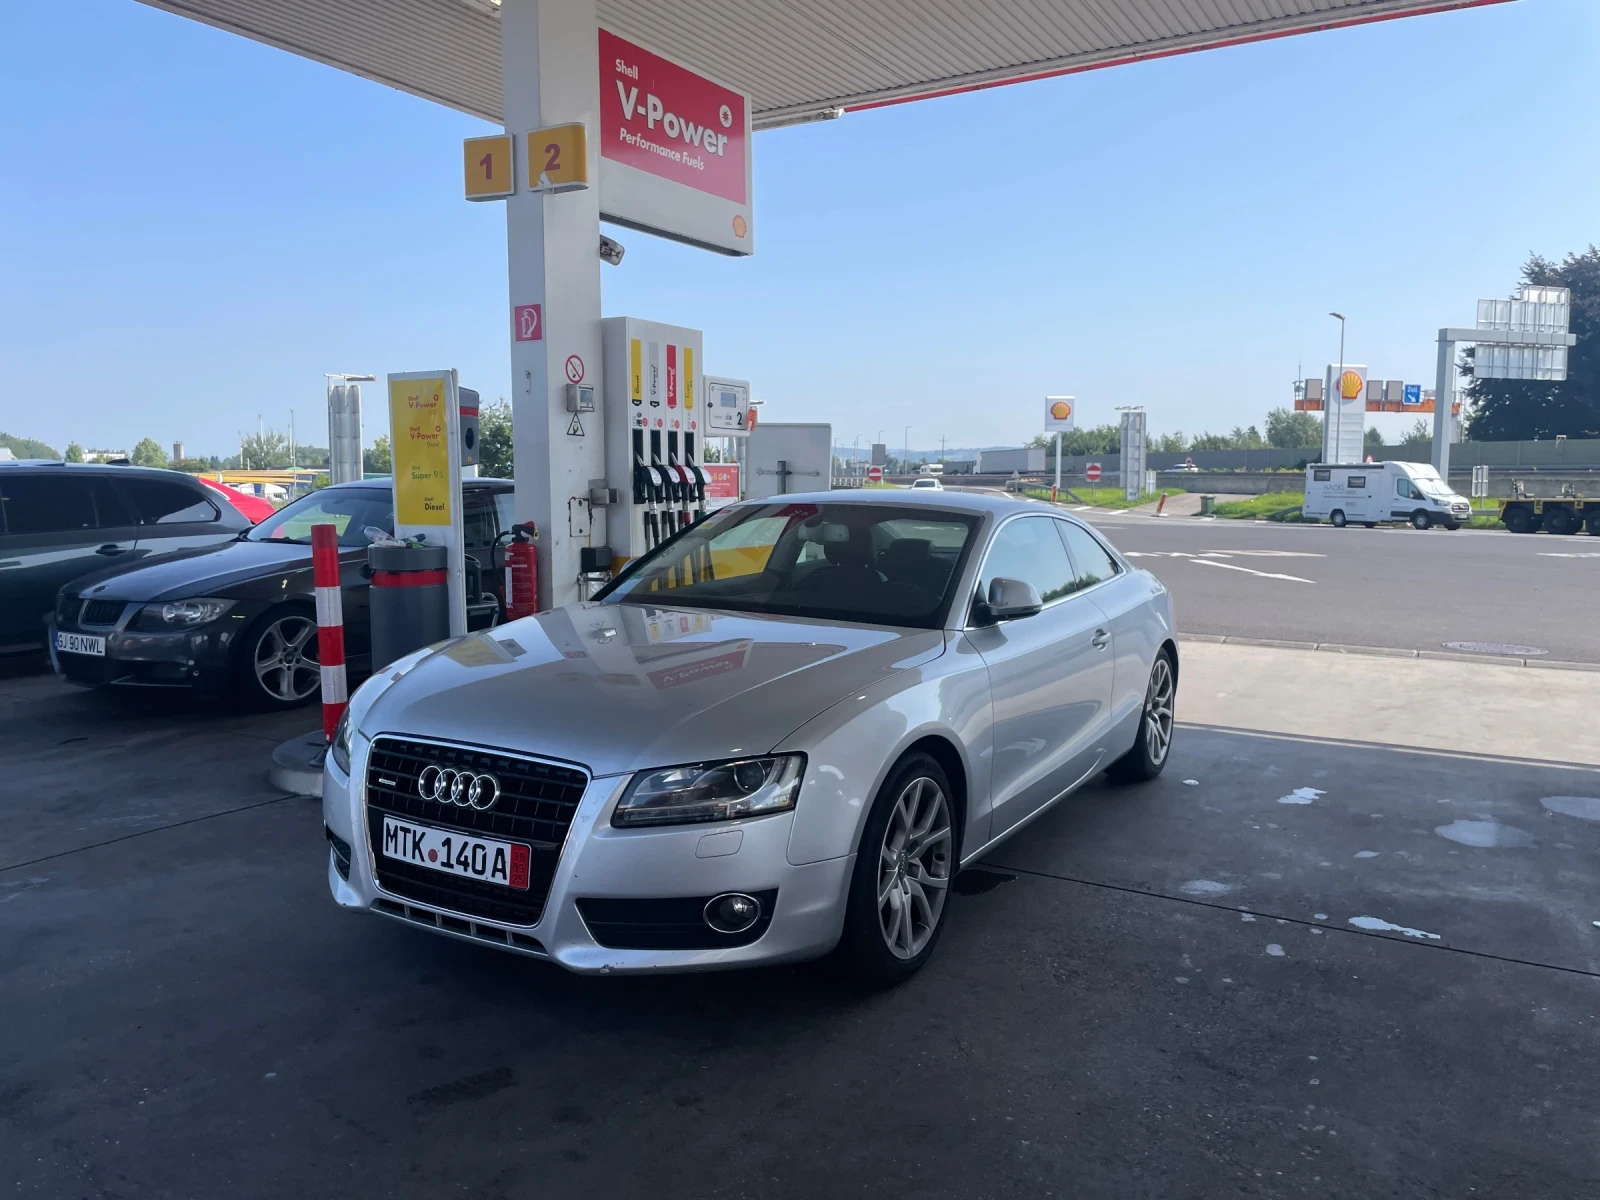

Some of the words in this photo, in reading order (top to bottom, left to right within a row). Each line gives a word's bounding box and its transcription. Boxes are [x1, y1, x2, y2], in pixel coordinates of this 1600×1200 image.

[616, 58, 639, 80] Shell
[616, 79, 728, 157] V-Power
[544, 143, 561, 171] 2
[619, 127, 681, 162] Performance
[682, 151, 705, 170] Fuels
[480, 153, 493, 180] 1
[408, 401, 437, 409] V-Power
[736, 411, 743, 426] 2
[410, 432, 439, 440] V-Power
[411, 471, 431, 481] Super
[433, 470, 443, 479] 95
[424, 502, 445, 511] Diesel
[58, 634, 67, 649] GJ
[69, 636, 79, 651] 90
[80, 637, 103, 654] NWL
[385, 822, 426, 863] MTK
